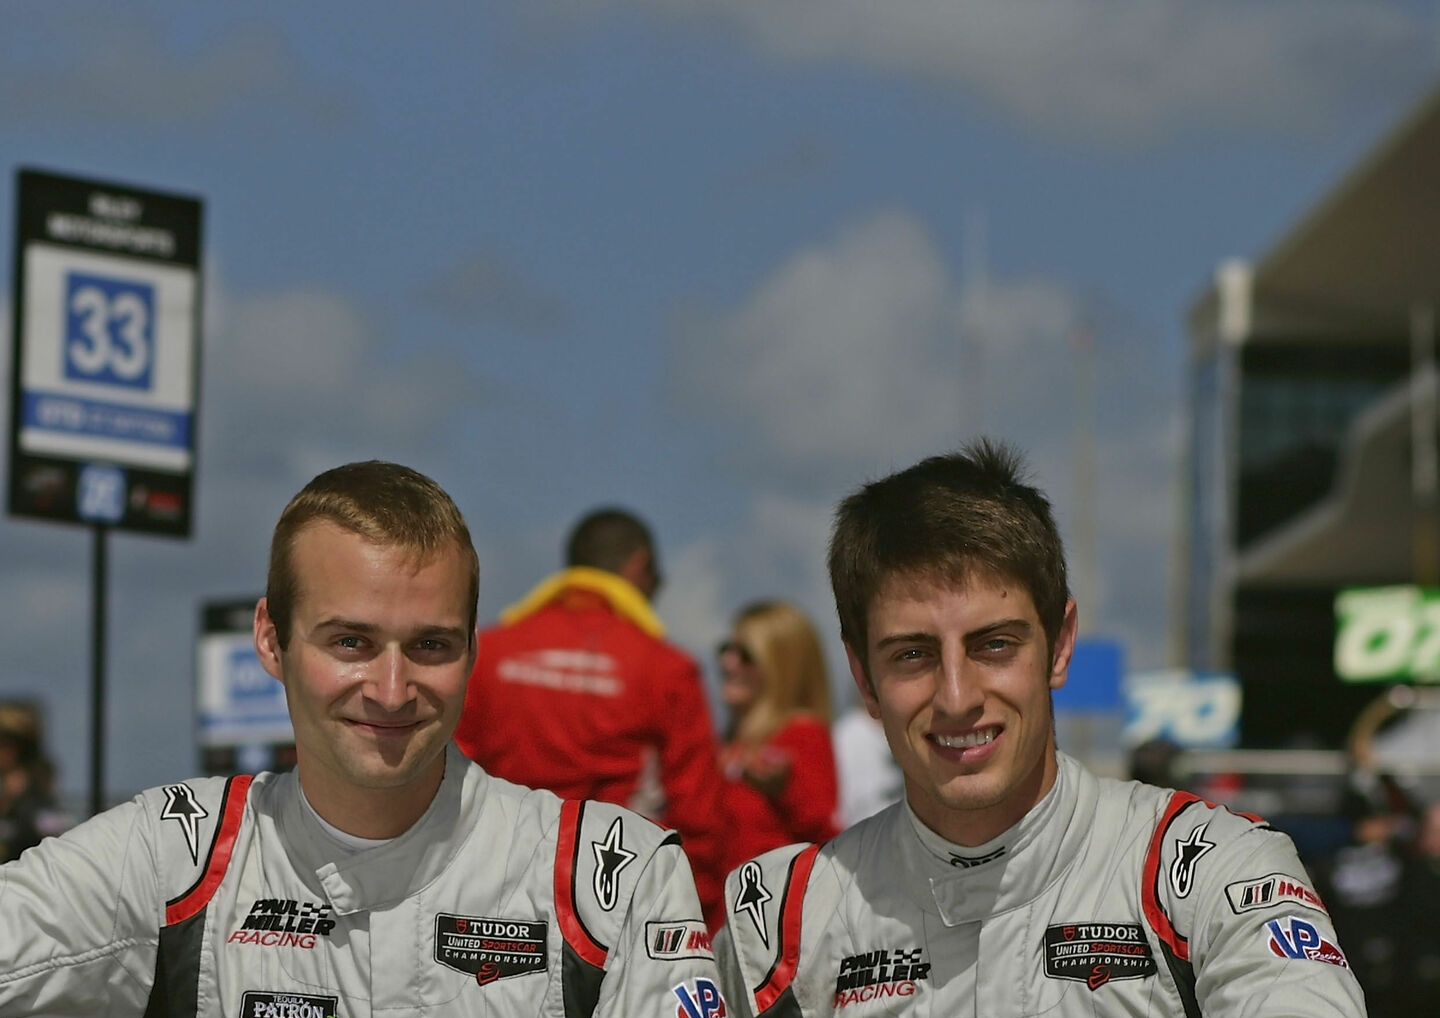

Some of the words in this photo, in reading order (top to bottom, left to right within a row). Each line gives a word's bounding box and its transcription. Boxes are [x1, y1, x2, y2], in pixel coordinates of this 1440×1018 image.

[69, 287, 150, 381] 33
[1278, 881, 1328, 913] IMS
[249, 899, 299, 916] PAUL
[241, 915, 335, 936] MILLER
[470, 921, 530, 938] TUDOR
[1078, 926, 1138, 940] TUDOR
[227, 930, 317, 949] RACING
[447, 936, 480, 949] UNITED
[481, 939, 537, 952] SPORTSCAR
[685, 930, 714, 952] IM
[1264, 915, 1321, 960] VP
[444, 949, 542, 965] CHAMPIONSHIP
[1055, 943, 1090, 956] UNITED
[840, 949, 891, 974] PAUL
[1054, 956, 1150, 969] CHAMPIONSHIP
[836, 963, 931, 993] MILLER
[272, 995, 304, 1005] TEQUILA
[832, 980, 916, 1009] RACING
